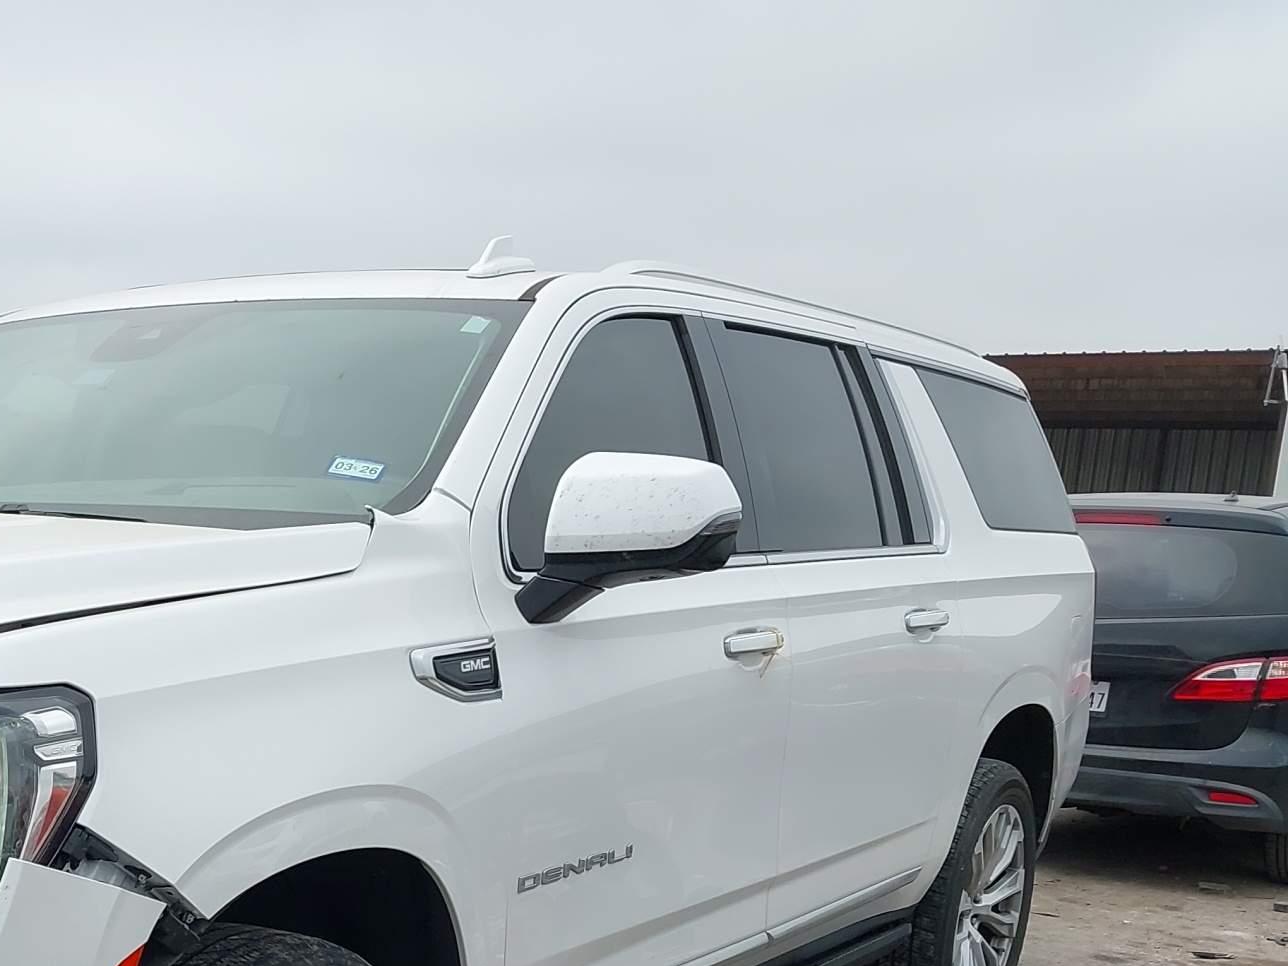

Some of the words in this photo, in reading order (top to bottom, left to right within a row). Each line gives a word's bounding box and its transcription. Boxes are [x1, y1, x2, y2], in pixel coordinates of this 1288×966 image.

[359, 465, 380, 475] 26
[460, 655, 491, 673] GMC
[517, 842, 633, 894] DENALI
